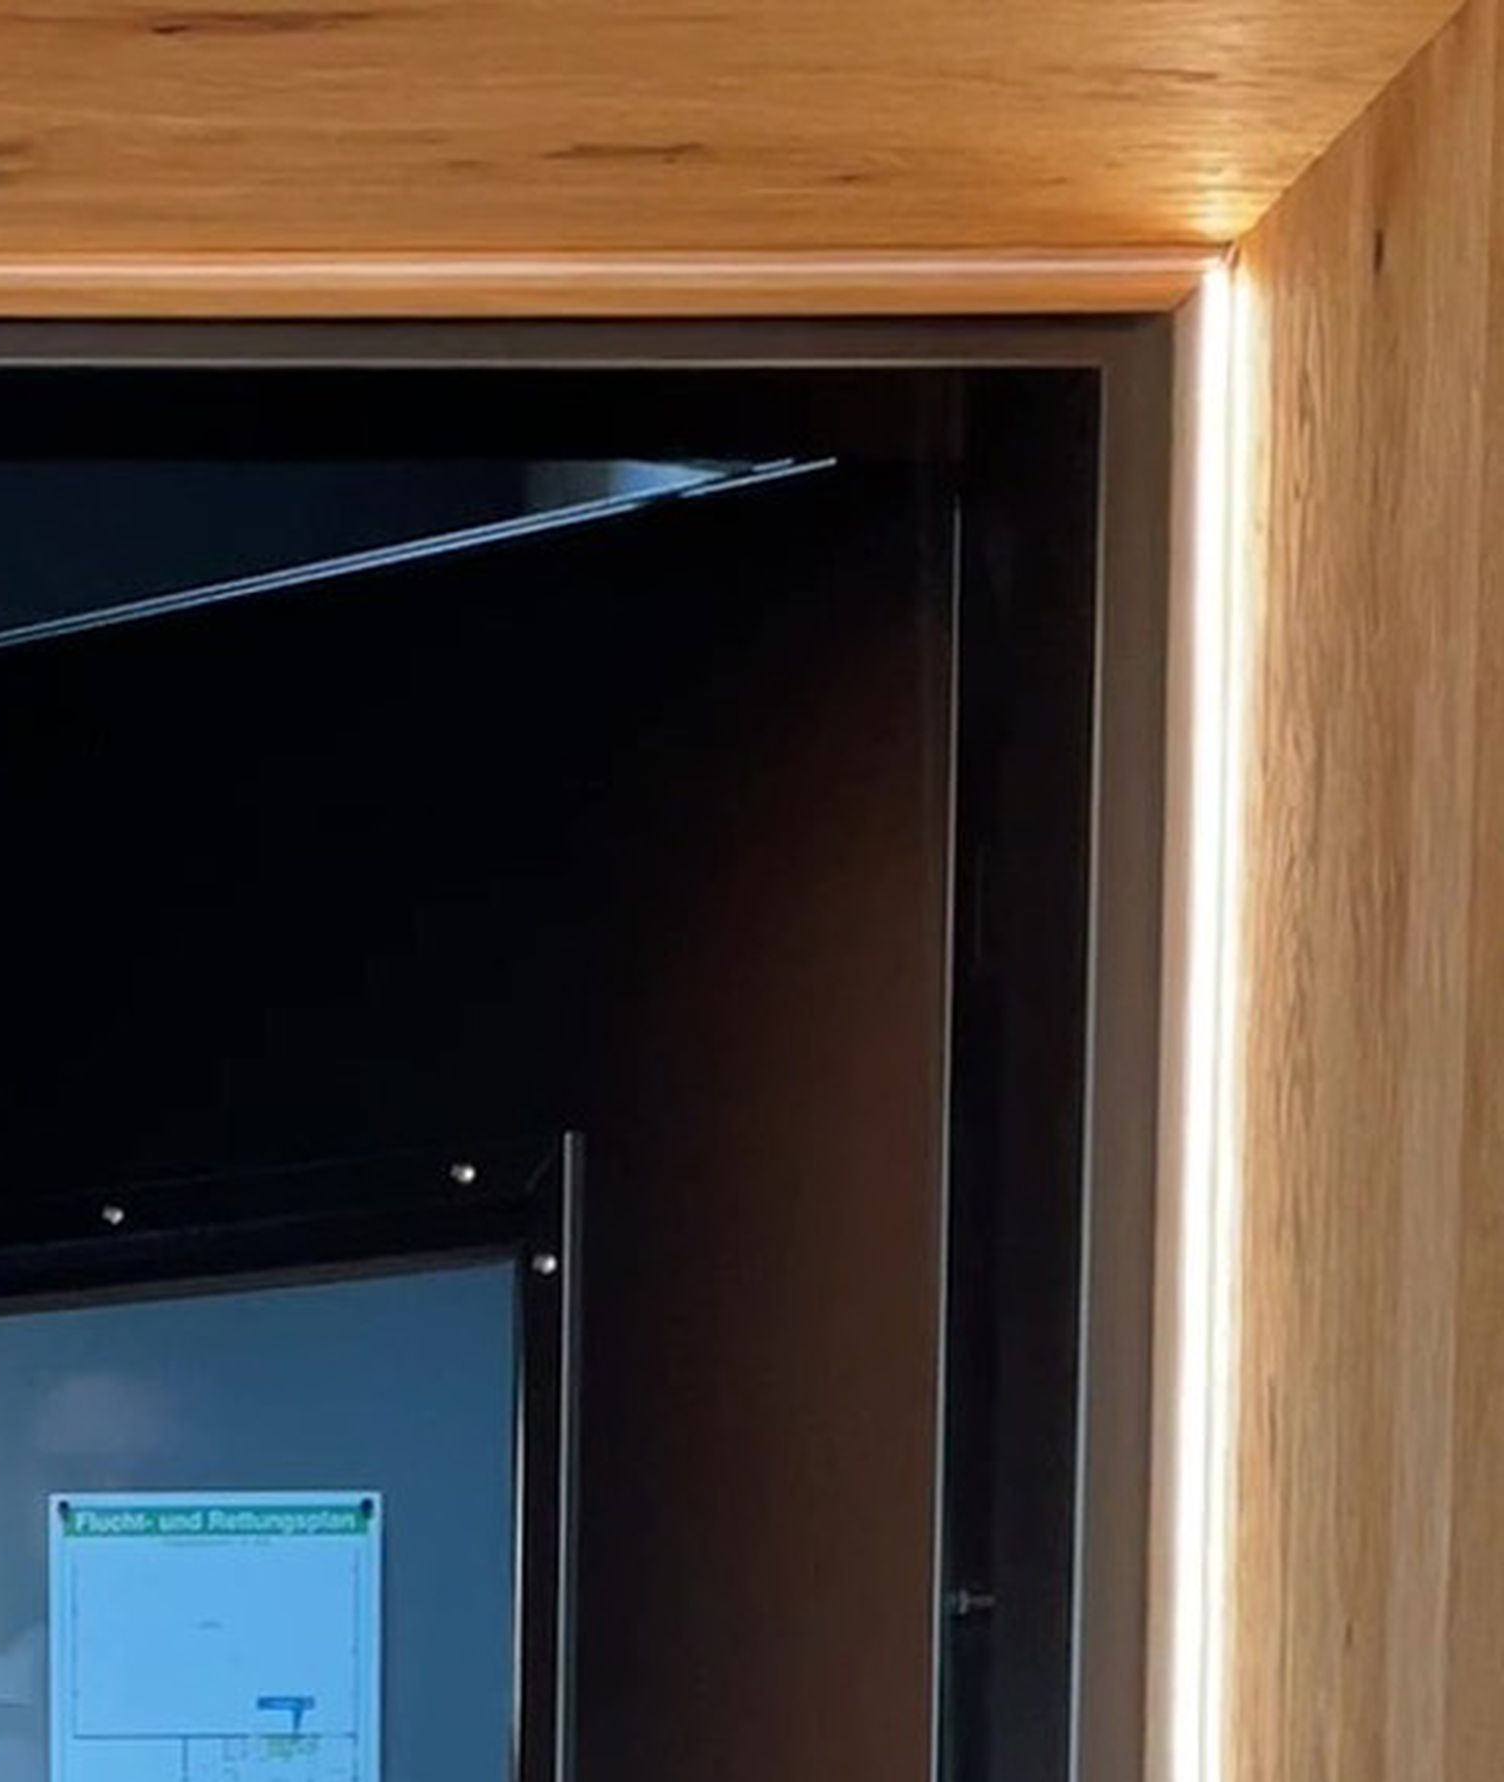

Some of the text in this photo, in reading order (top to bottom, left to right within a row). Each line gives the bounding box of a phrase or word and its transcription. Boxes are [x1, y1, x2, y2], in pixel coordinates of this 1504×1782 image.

[75, 1511, 356, 1535] Flucht- und Rettungsplan
